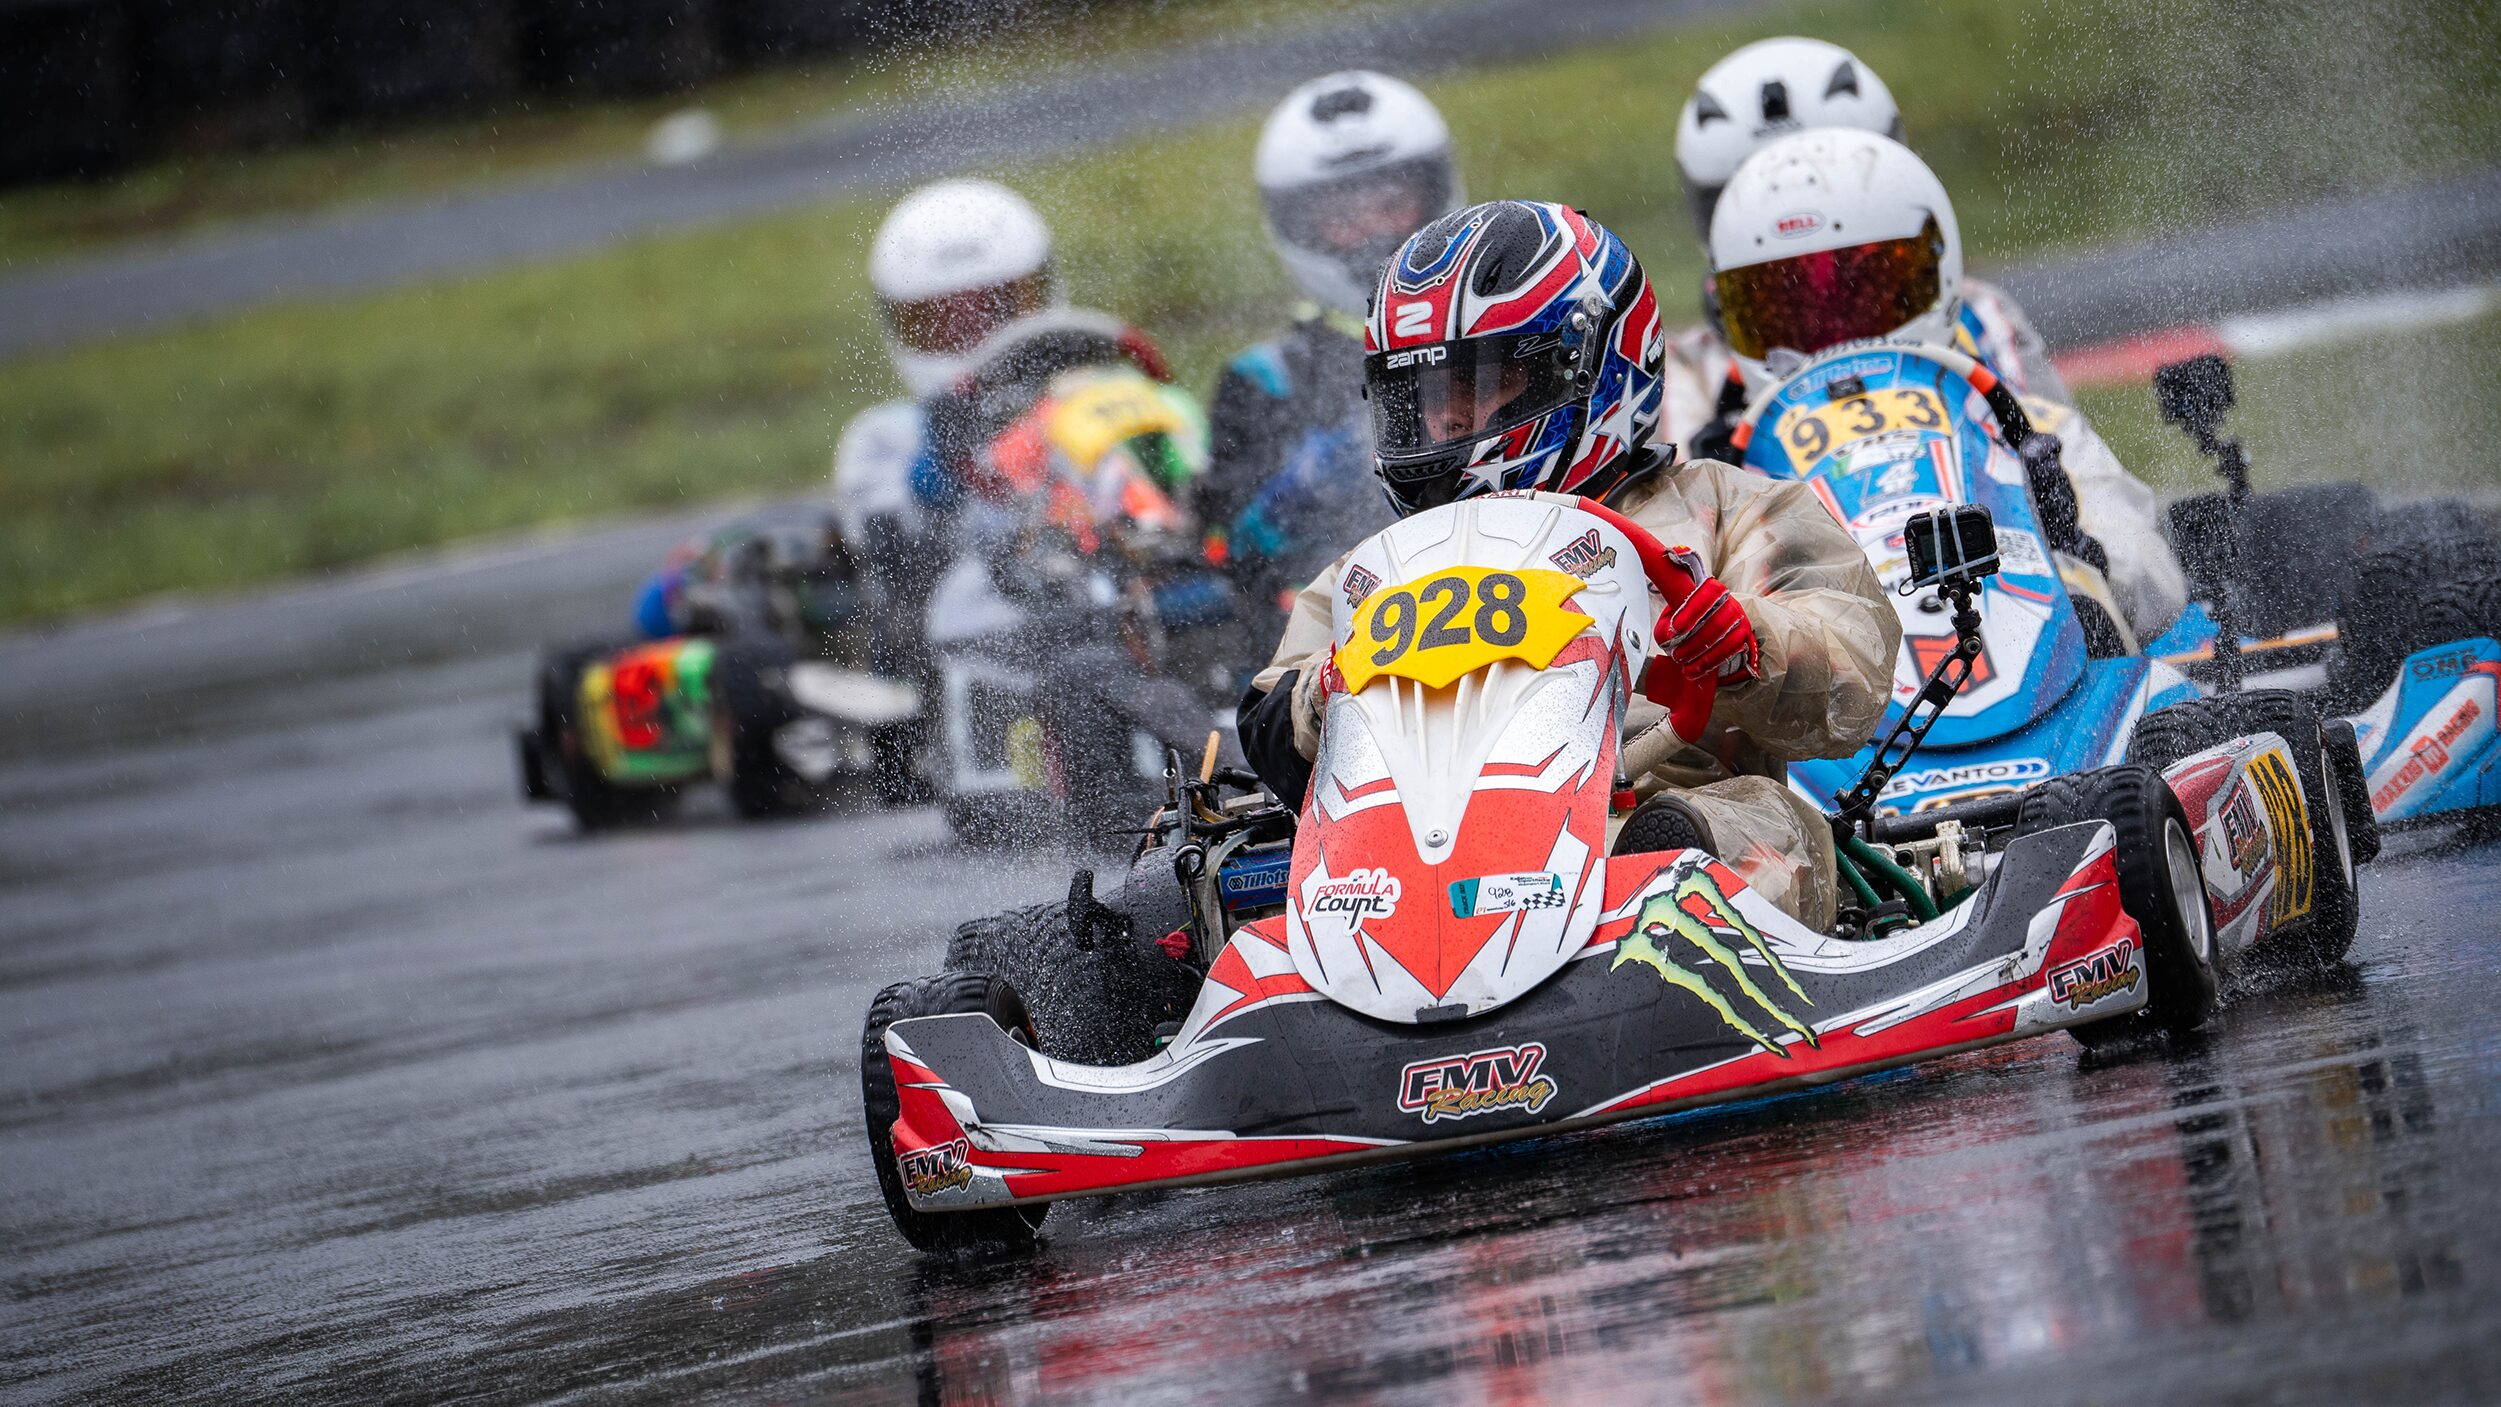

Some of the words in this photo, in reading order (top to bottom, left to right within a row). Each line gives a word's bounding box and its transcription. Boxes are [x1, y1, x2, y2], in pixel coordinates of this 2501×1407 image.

[1777, 216, 1818, 233] BELL
[1387, 346, 1447, 370] zamp
[1792, 390, 1941, 461] 933
[1551, 531, 1600, 573] FMV
[1369, 573, 1527, 667] 928
[1243, 869, 1290, 888] Tillots
[1308, 874, 1394, 915] FORMULA
[2048, 940, 2132, 1003] FMV
[2070, 966, 2140, 1010] Racing
[1403, 1046, 1543, 1107] FMV
[1427, 1080, 1551, 1119] Racing
[901, 1141, 967, 1188] FMV
[914, 1166, 973, 1198] Racing
